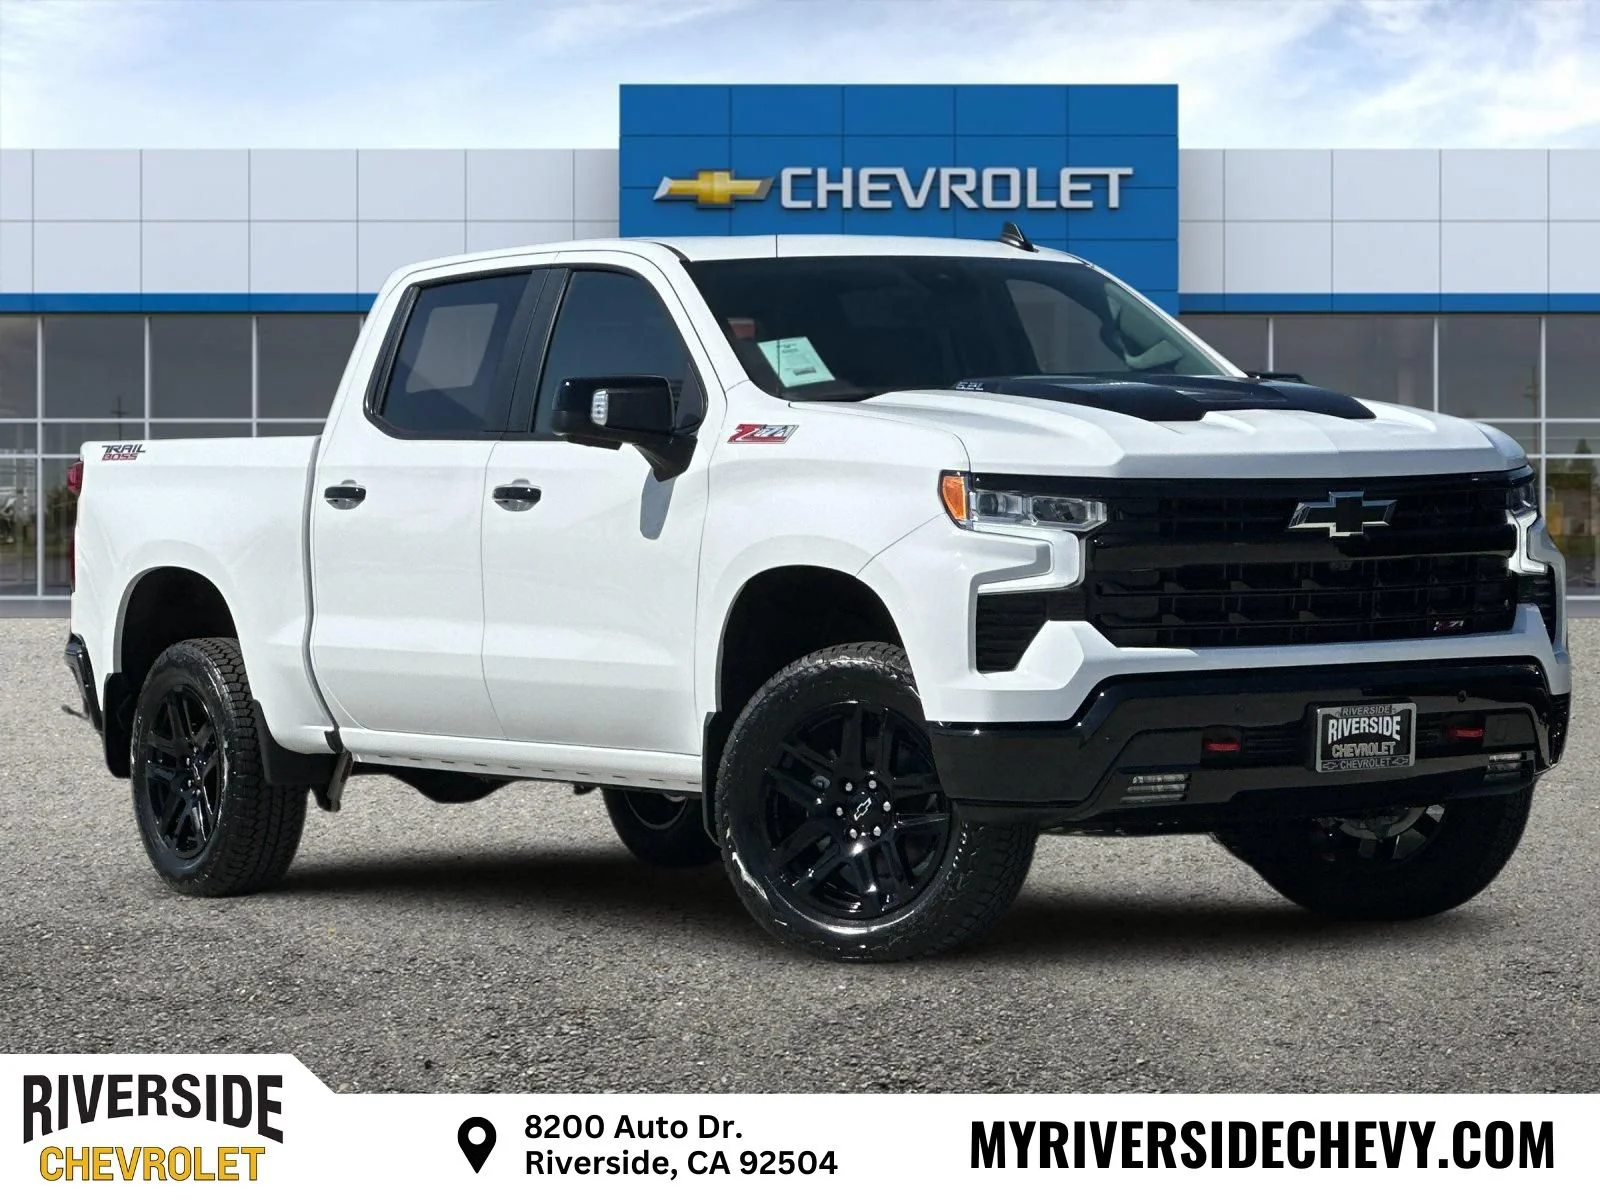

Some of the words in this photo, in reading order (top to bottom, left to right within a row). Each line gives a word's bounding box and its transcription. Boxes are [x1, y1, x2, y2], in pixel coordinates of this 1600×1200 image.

[780, 167, 1133, 209] CHEVROLET
[728, 424, 798, 443] Z71
[101, 444, 146, 454] TRAIL
[101, 453, 138, 461] BOSS
[1342, 705, 1391, 716] RIVERSIDE
[1328, 715, 1401, 745] RIVERSIDE
[1331, 741, 1396, 758] CHEVROLET
[1340, 757, 1392, 770] CHEVROLET
